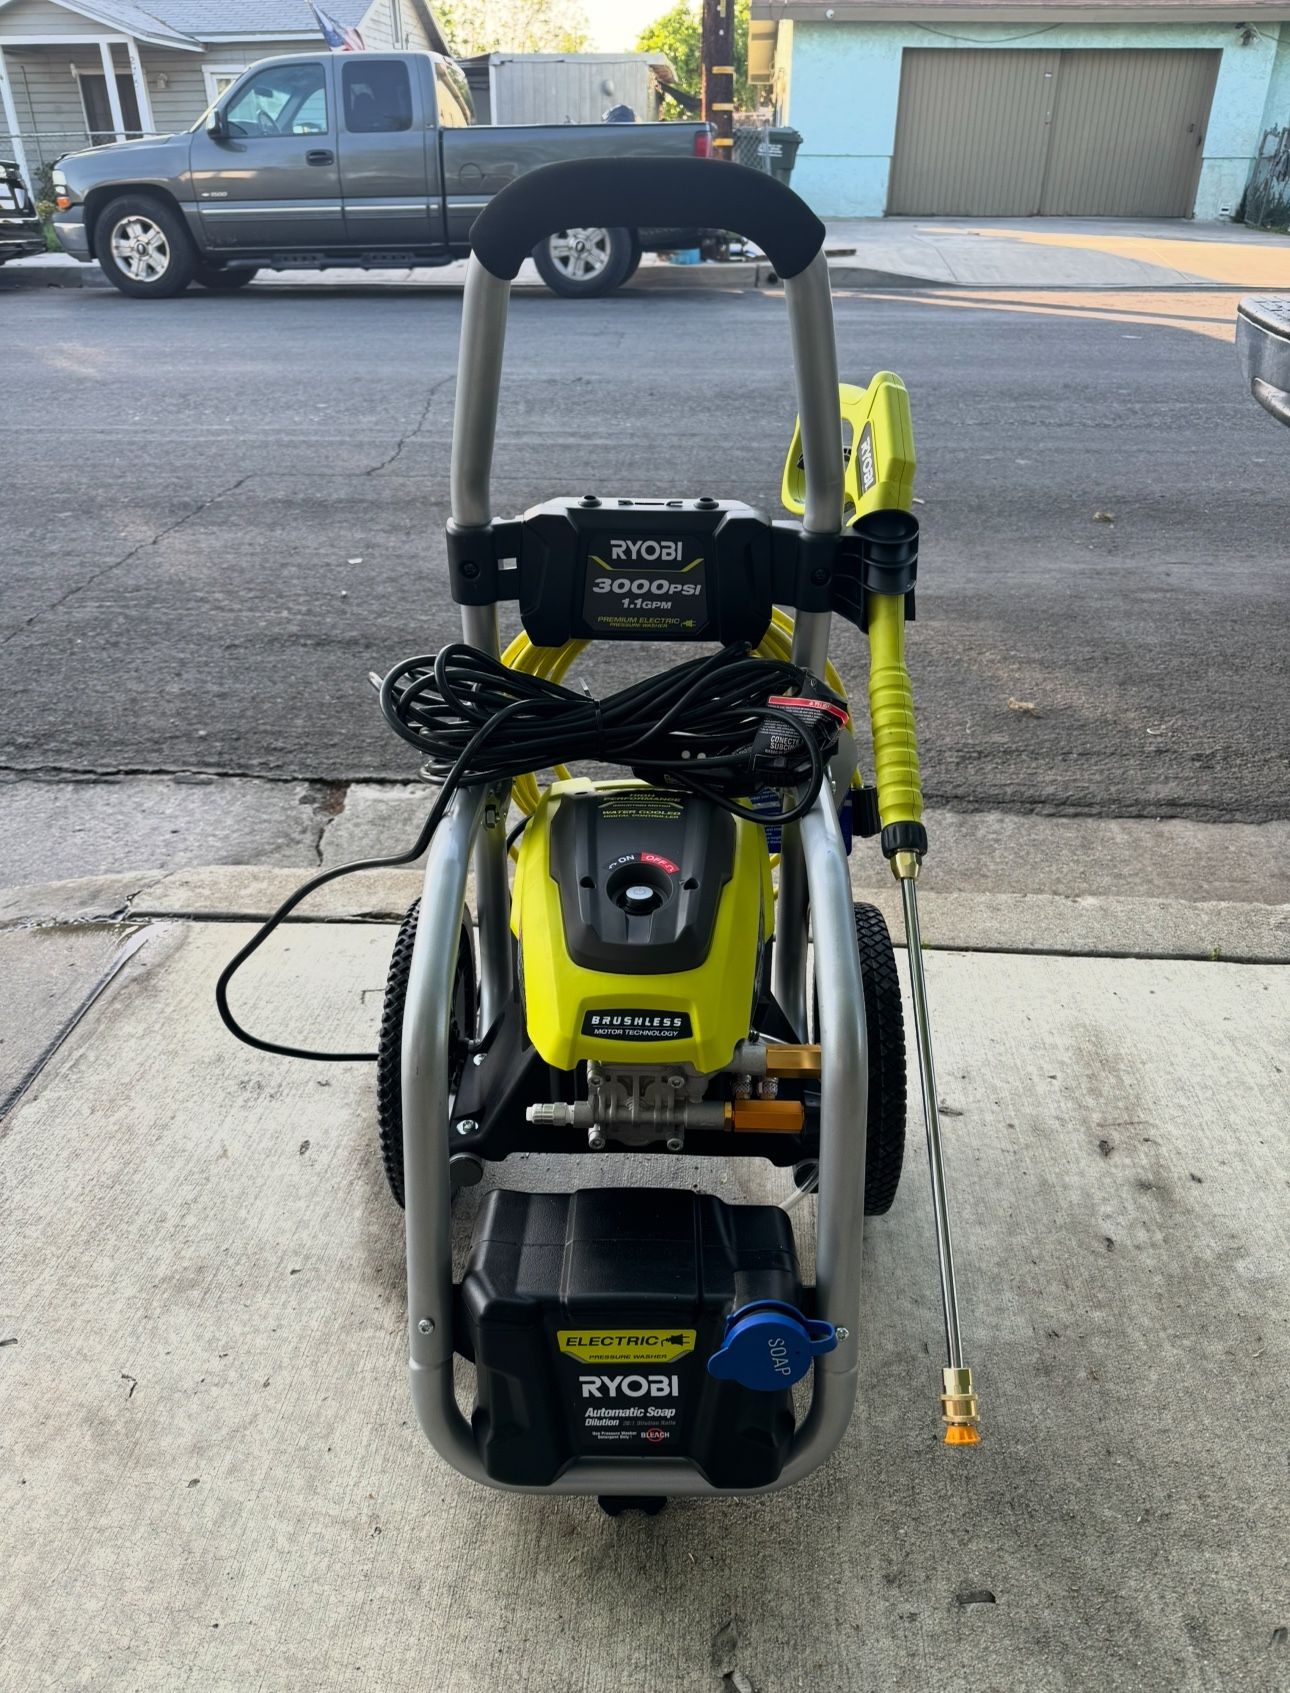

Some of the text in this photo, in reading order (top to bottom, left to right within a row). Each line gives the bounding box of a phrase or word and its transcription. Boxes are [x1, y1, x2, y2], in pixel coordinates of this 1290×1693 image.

[860, 436, 875, 490] RYOBI
[610, 539, 683, 561] RYOBI
[639, 617, 680, 625] ELECTRIC
[618, 854, 667, 866] ON OFF
[591, 1015, 682, 1027] BRUSHLESS
[624, 1029, 679, 1037] TECHNOLOGY
[565, 1336, 659, 1347] ELECTRIC
[767, 1338, 792, 1376] SOAP
[578, 1374, 679, 1398] RYOBI
[584, 1406, 676, 1419] Automatic Soap
[584, 1418, 619, 1426] Dilution
[640, 1431, 670, 1439] BLEACH
